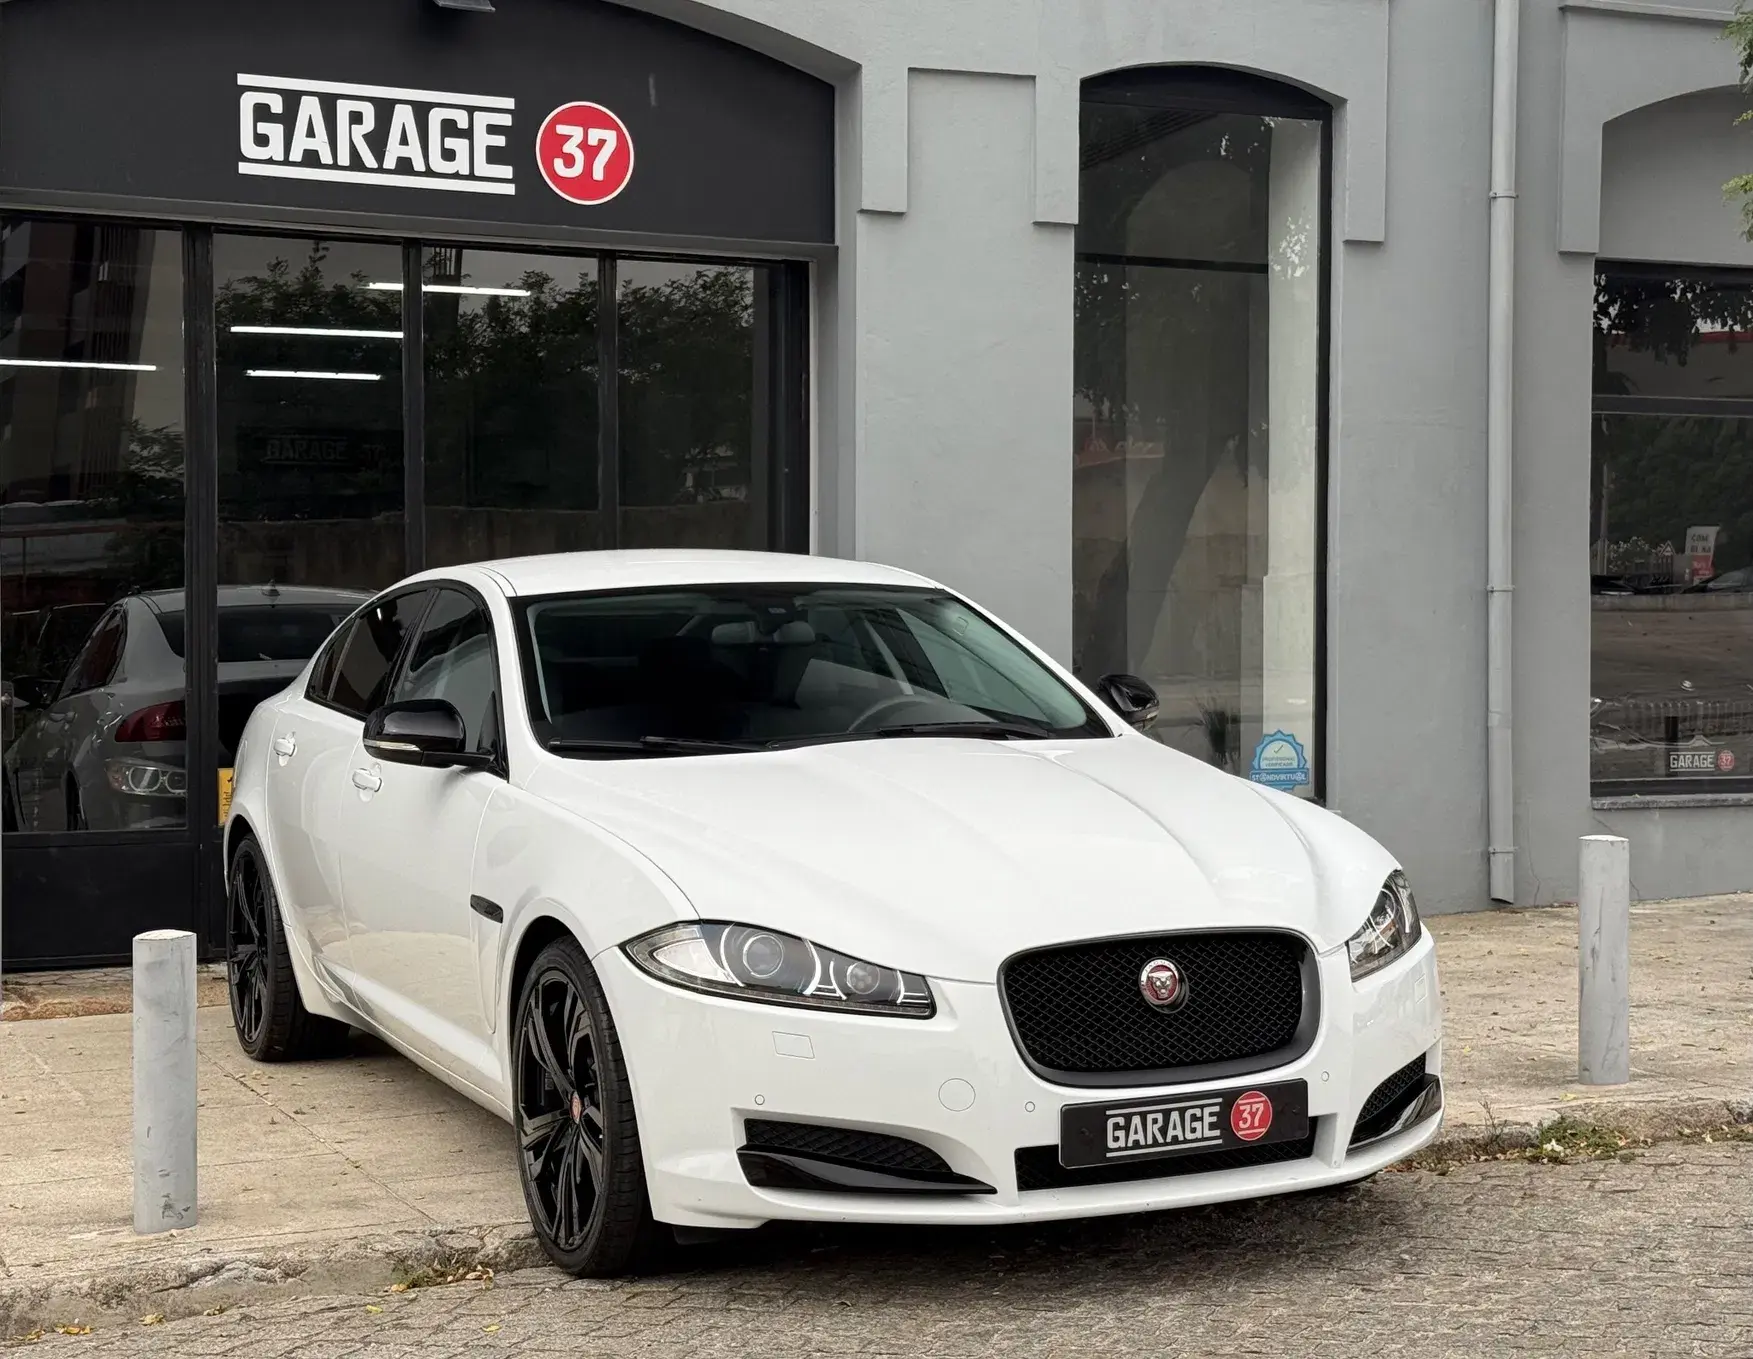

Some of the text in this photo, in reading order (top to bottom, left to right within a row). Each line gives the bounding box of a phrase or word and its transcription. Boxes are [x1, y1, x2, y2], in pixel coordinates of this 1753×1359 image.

[239, 91, 617, 181] GARAGE 37
[1670, 754, 1732, 768] GARAGE 37
[1106, 1102, 1264, 1149] GARAGE 37
